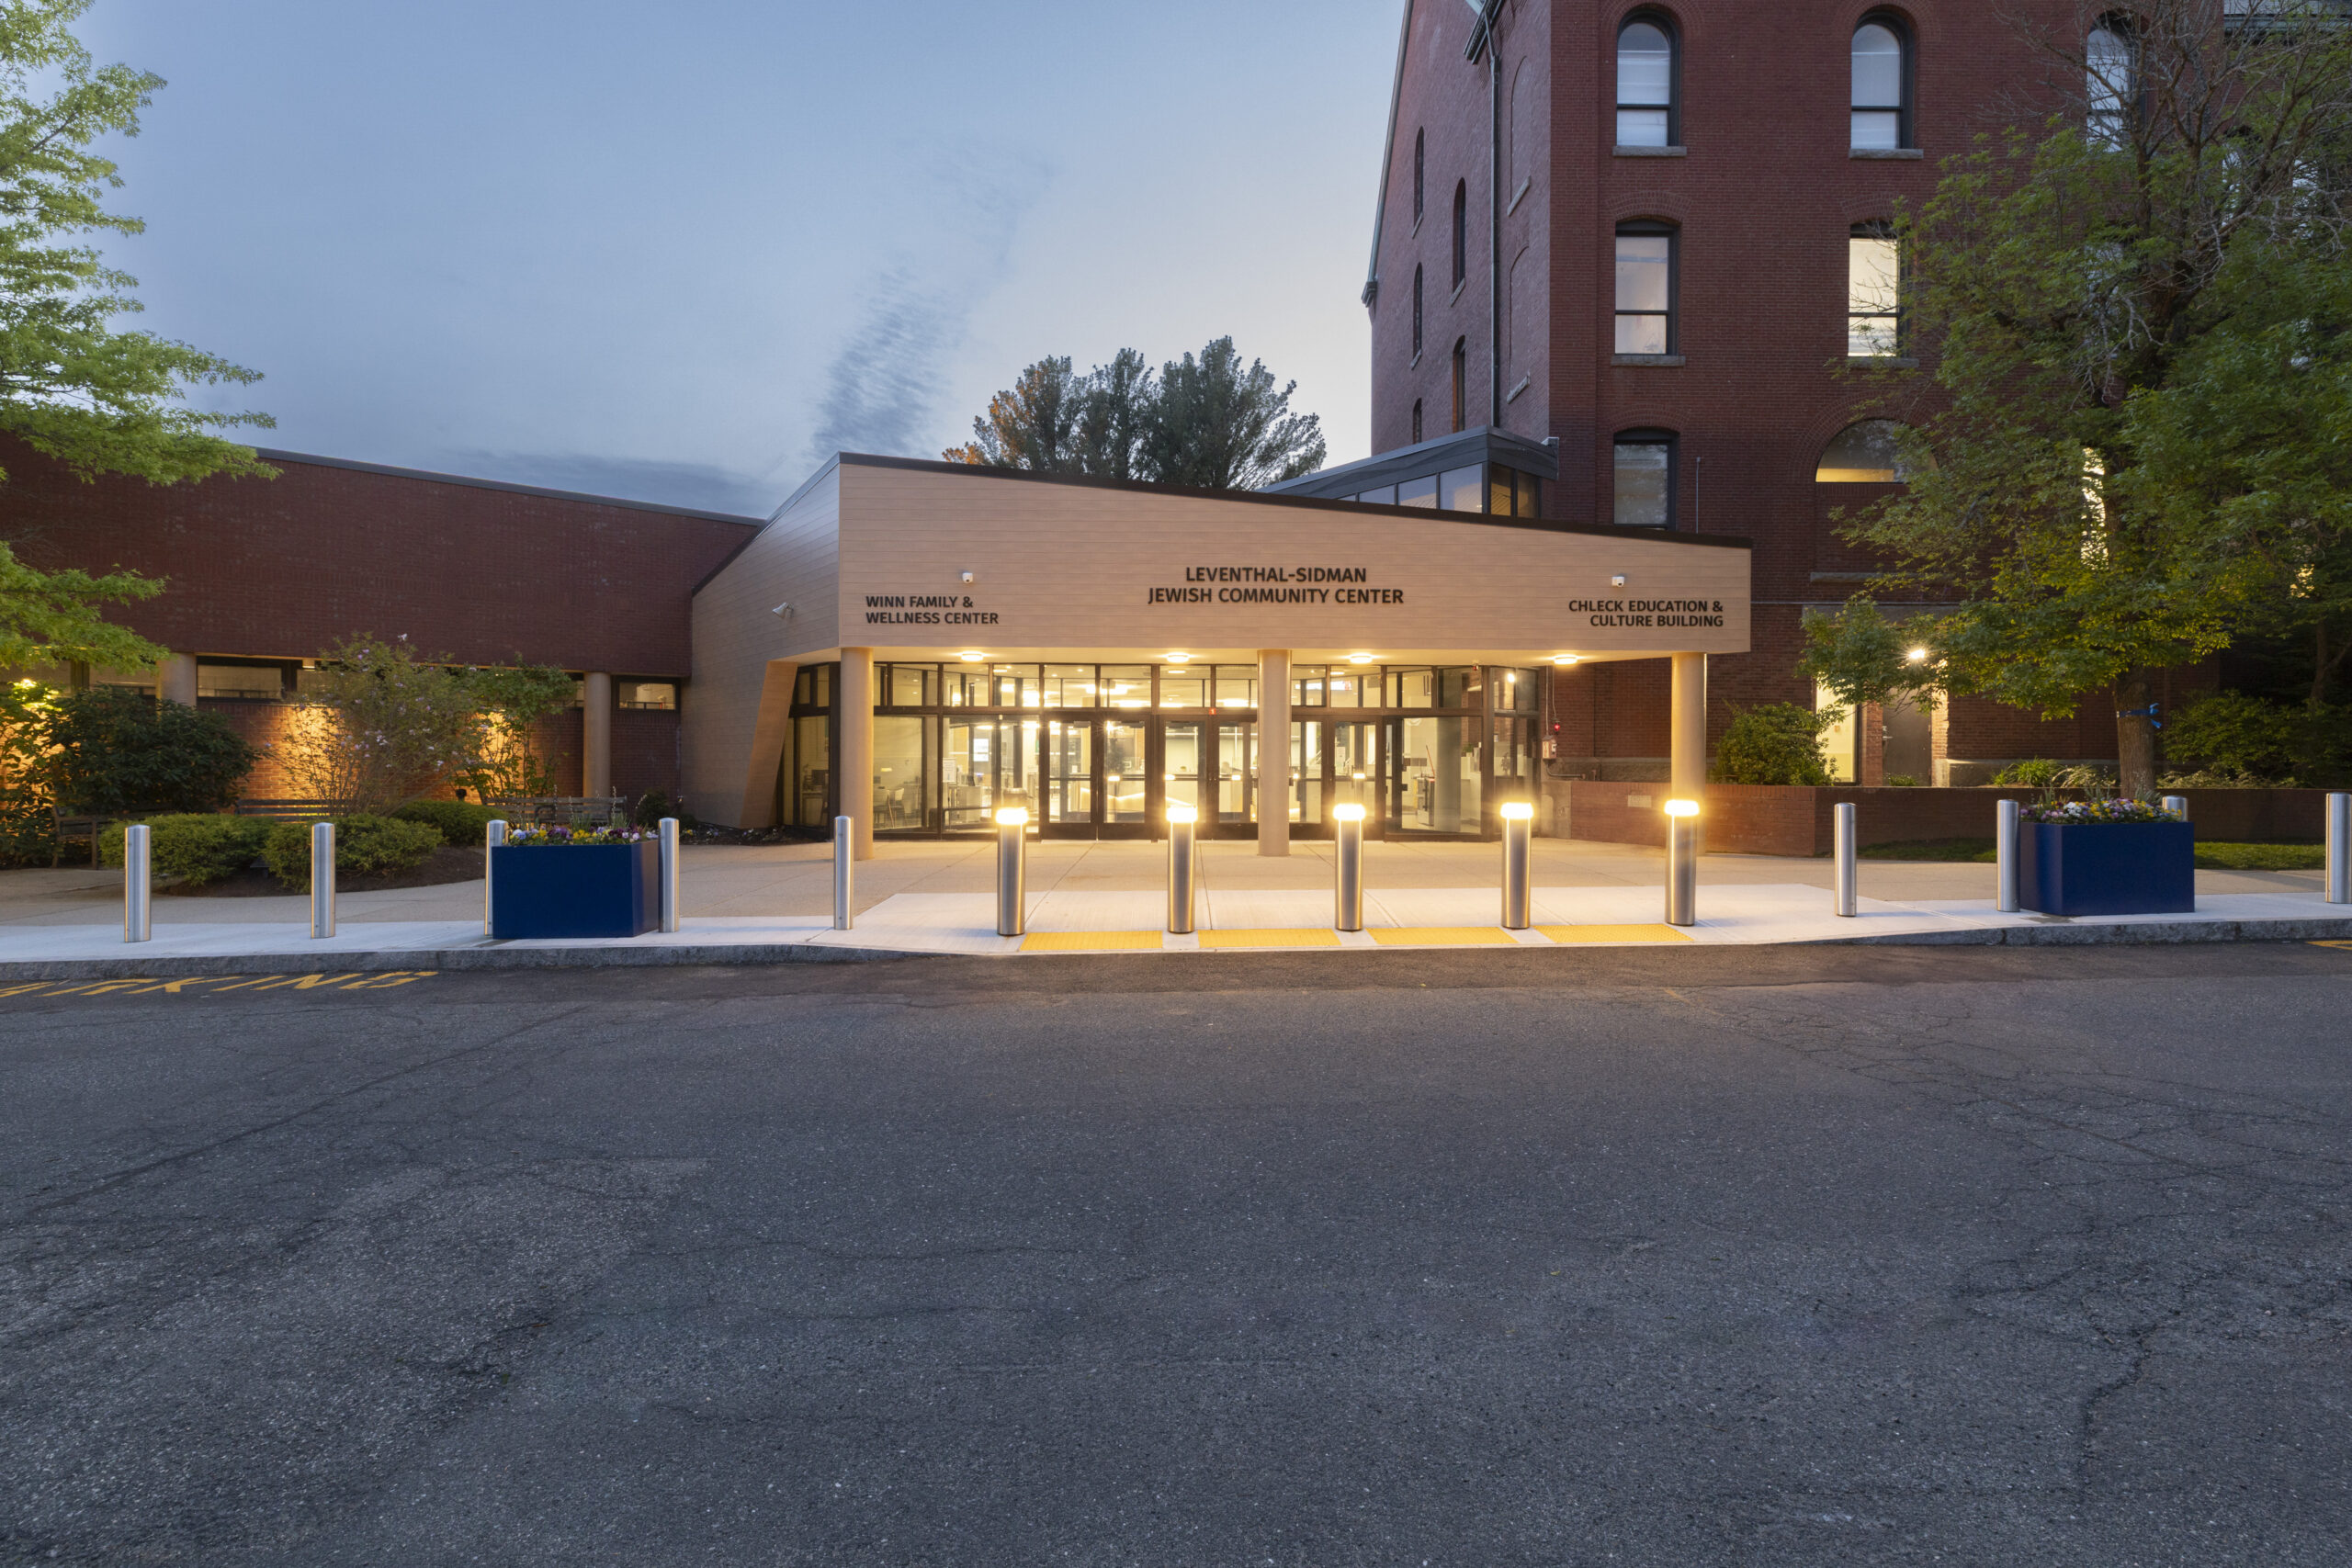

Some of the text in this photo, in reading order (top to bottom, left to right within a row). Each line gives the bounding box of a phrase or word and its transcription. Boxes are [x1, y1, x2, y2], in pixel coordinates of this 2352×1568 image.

[1185, 567, 1367, 582] LEVENTHAL-SIDMAN
[865, 595, 974, 608] WINN FAMILY &
[1148, 587, 1404, 604] JEWISH COMMUNITY CENTER
[1568, 600, 1724, 613] CHLECK EDUCATION &
[865, 612, 999, 625] WELLNESS CENTER
[1589, 615, 1724, 627] CULTURE BUILDING
